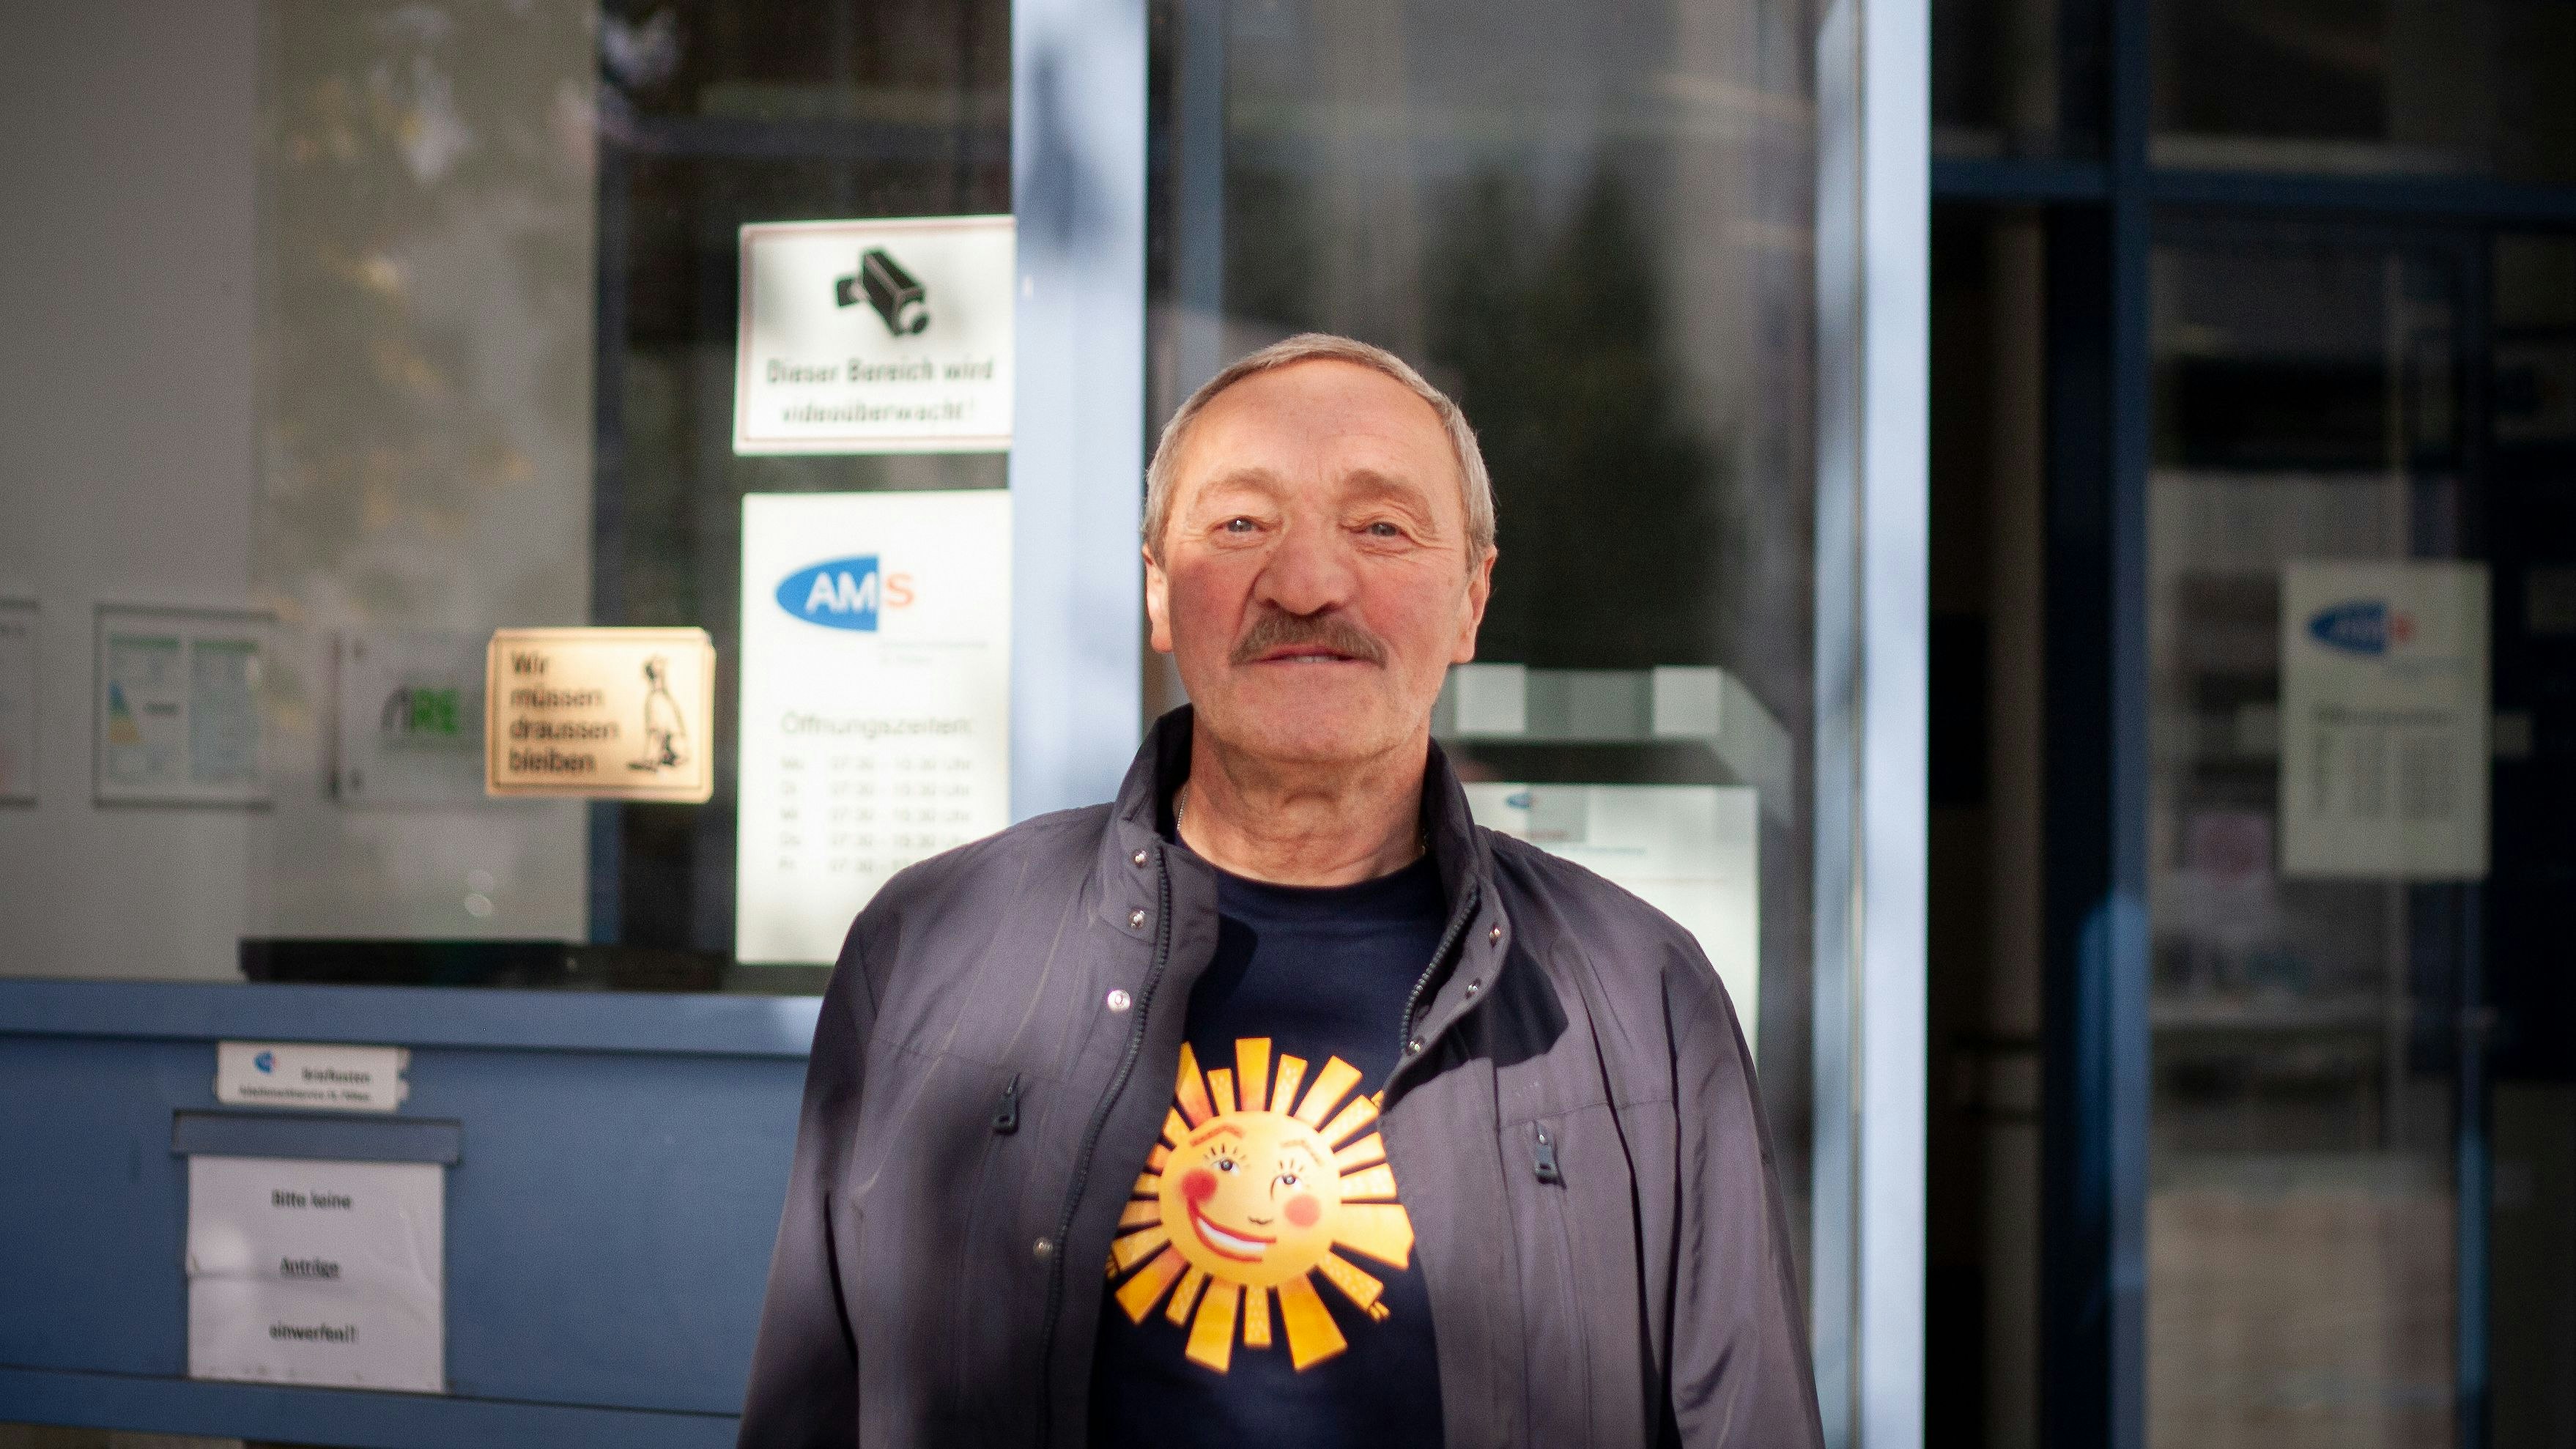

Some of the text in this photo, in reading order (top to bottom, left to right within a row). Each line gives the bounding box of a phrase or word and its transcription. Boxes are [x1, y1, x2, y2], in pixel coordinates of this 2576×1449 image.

[766, 355, 993, 384] Dieser Bereich wird
[805, 571, 915, 614] AMS
[511, 651, 549, 675] Wir
[511, 682, 604, 708] müssen
[509, 714, 621, 741] draussen
[508, 747, 597, 773] bleiben
[272, 1189, 353, 1210] Bitte keine
